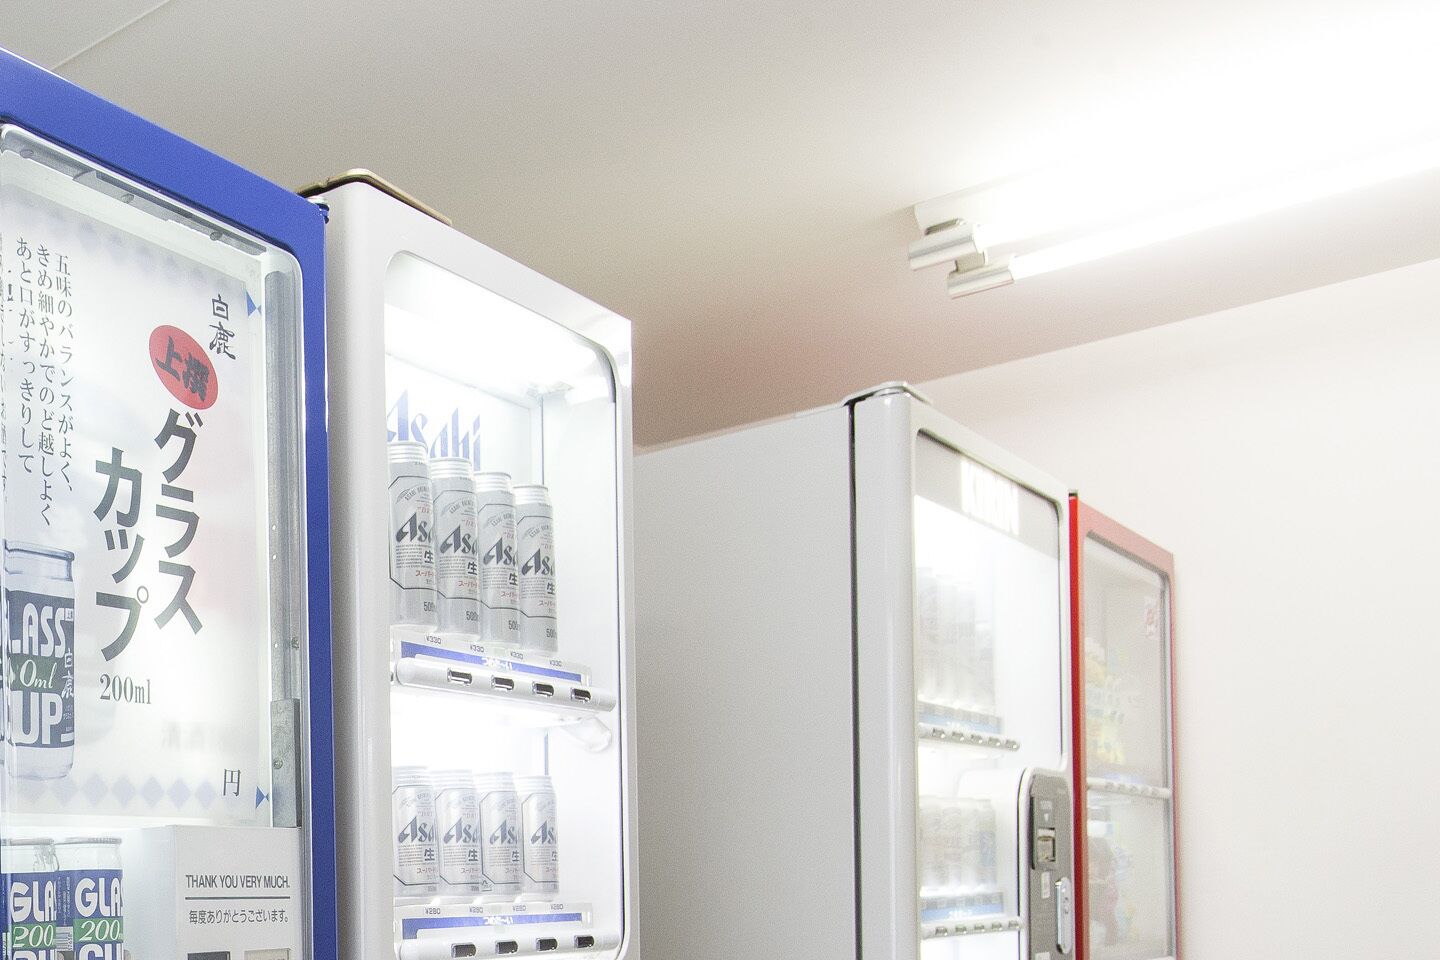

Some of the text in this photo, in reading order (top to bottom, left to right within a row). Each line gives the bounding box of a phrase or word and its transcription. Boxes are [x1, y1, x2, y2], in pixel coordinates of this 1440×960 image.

[16, 237, 35, 474] あと口がすっきりして
[35, 244, 55, 526] きめ細やかでのど越しよく
[55, 253, 74, 492] 五味のバランスがよく、
[387, 389, 481, 471] Asahi
[93, 447, 150, 662] カップ
[154, 408, 204, 635] グラス
[99, 673, 152, 705] 200ml
[223, 769, 241, 797] 円
[185, 874, 290, 889] THANK YOU VERY MUCH.
[189, 909, 289, 926] 毎度ありがとうございます。
